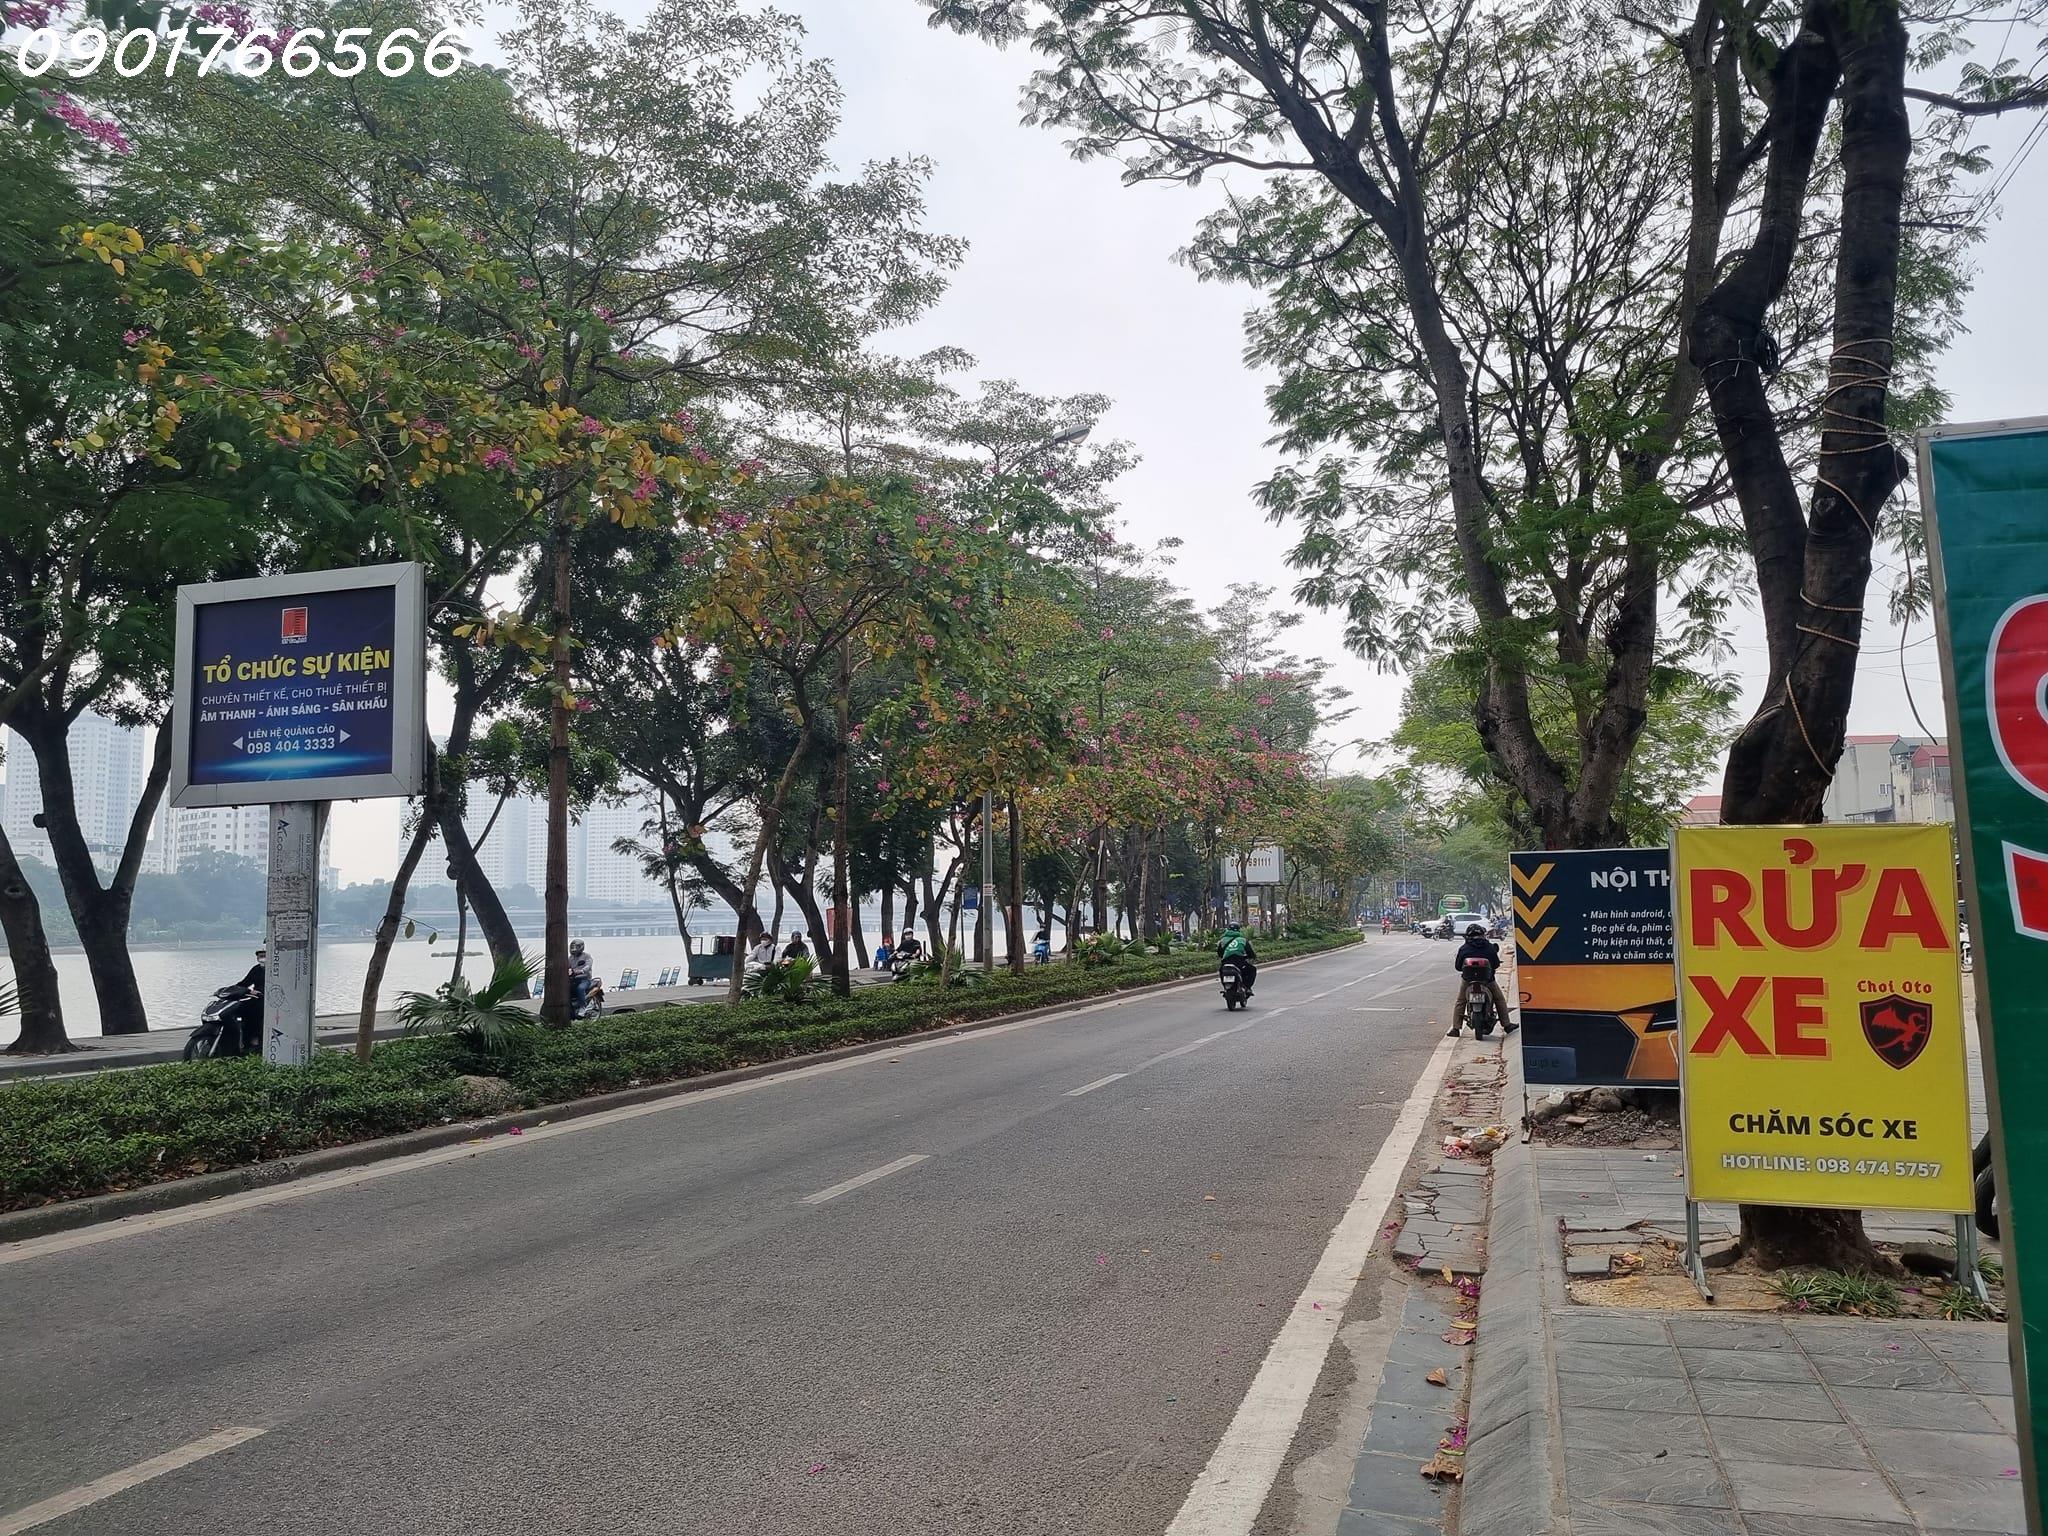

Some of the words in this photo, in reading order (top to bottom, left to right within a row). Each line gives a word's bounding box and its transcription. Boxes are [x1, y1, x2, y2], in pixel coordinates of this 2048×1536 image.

[203, 654, 232, 683] TỔ
[237, 654, 297, 681] CHỨC
[302, 652, 334, 680] SỰ
[337, 645, 390, 676] KIỆN
[201, 692, 240, 705] CHUYÊN
[243, 688, 271, 702] THIẾT
[273, 686, 289, 701] KẾ,
[291, 688, 313, 698] CHO
[316, 683, 343, 697] THUÊ
[345, 680, 375, 694] THIẾT
[377, 681, 387, 693] BỊ
[200, 710, 217, 722] ÂM
[219, 708, 256, 720] THANH
[266, 705, 289, 718] ÁNH
[291, 703, 321, 715] SÁNG
[332, 699, 355, 712] SÂN
[357, 695, 388, 710] KHẤU
[248, 728, 268, 739] LIÊN
[270, 726, 282, 740] HỆ
[284, 724, 315, 738] QUẢNG
[247, 741, 271, 754] 098
[275, 740, 300, 752] 404
[304, 737, 335, 751] 3333
[1590, 866, 1637, 893] NỘI
[1689, 838, 1955, 952] RỬA
[1590, 910, 1608, 919] Màn
[1630, 908, 1665, 919] android,
[1591, 924, 1608, 935] Bọc
[1609, 922, 1626, 935] ghế
[1626, 923, 1640, 933] da,
[1641, 922, 1663, 934] phim
[1592, 937, 1608, 948] Phụ
[1610, 937, 1629, 948] kiện
[1630, 936, 1644, 948] nội
[1646, 935, 1665, 946] thất,
[1592, 950, 1609, 960] Rửa
[1611, 950, 1621, 960] và
[1623, 950, 1646, 959] chăm
[1648, 950, 1664, 959] sóc
[1857, 979, 1895, 993] Choi
[1902, 980, 1932, 994] Oto
[1688, 975, 1832, 1061] XE
[1729, 1109, 1811, 1136] CHĂM
[1819, 1112, 1874, 1138] SÓC
[1882, 1119, 1918, 1140] XE
[1721, 1154, 1811, 1172] HOTLINE:
[1816, 1158, 1850, 1173] 098
[1855, 1160, 1890, 1175] 474
[1895, 1162, 1942, 1178] 5757
